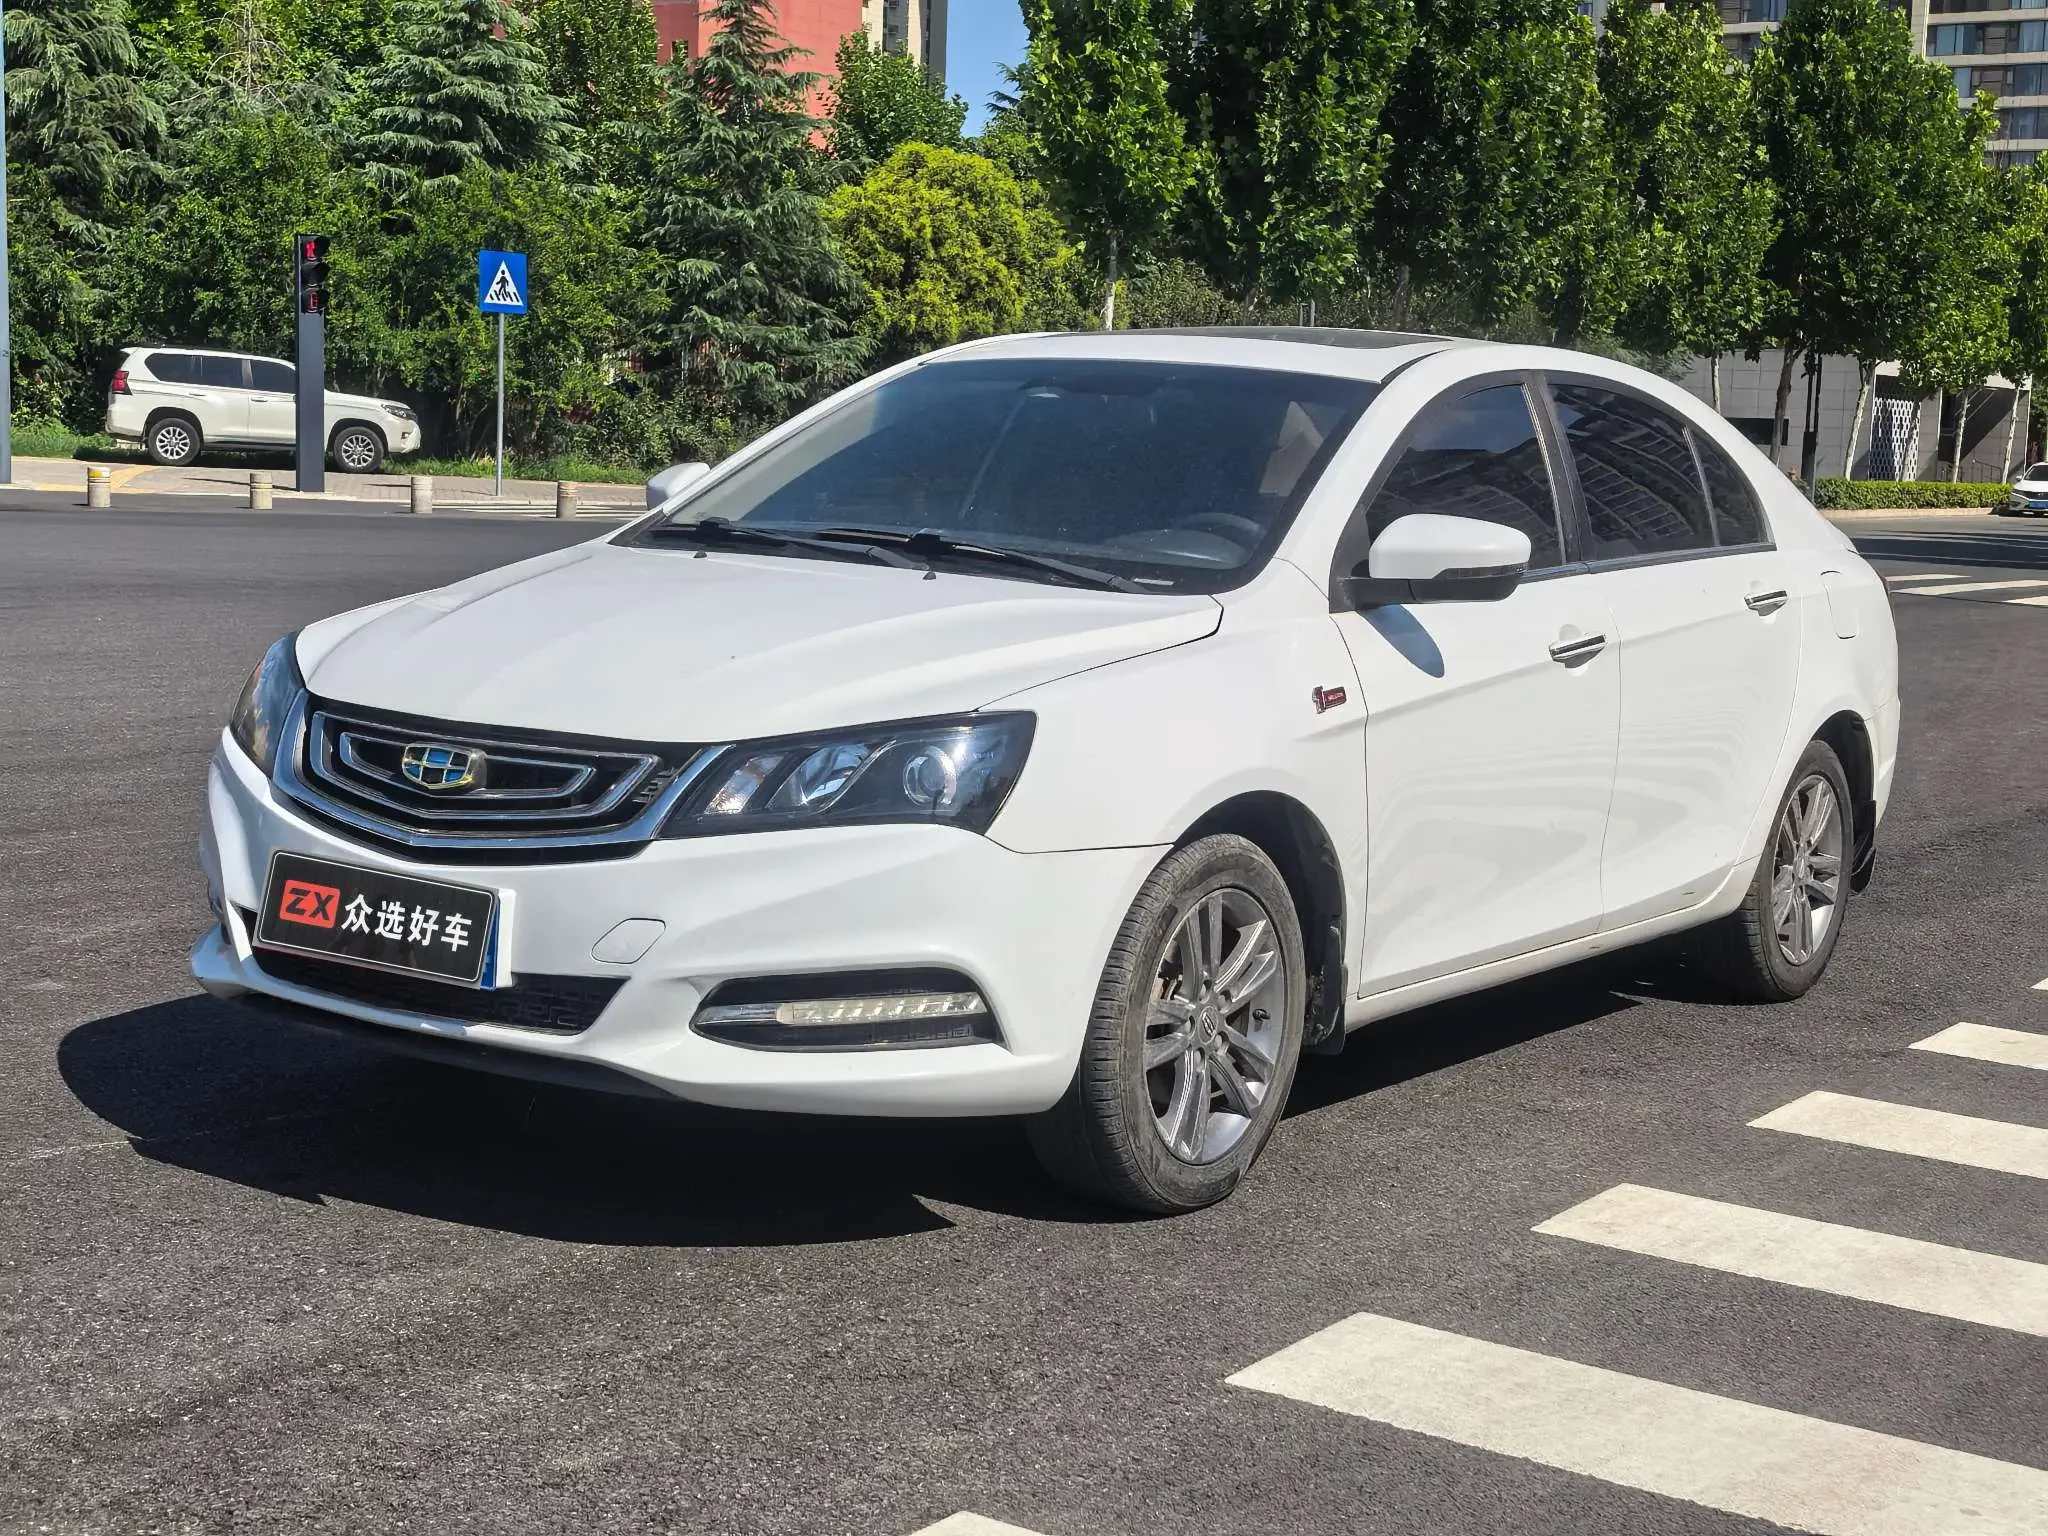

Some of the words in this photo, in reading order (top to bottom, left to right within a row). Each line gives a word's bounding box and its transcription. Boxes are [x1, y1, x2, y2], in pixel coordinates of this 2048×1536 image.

[284, 886, 335, 921] ZX
[341, 893, 473, 952] 众选好车
